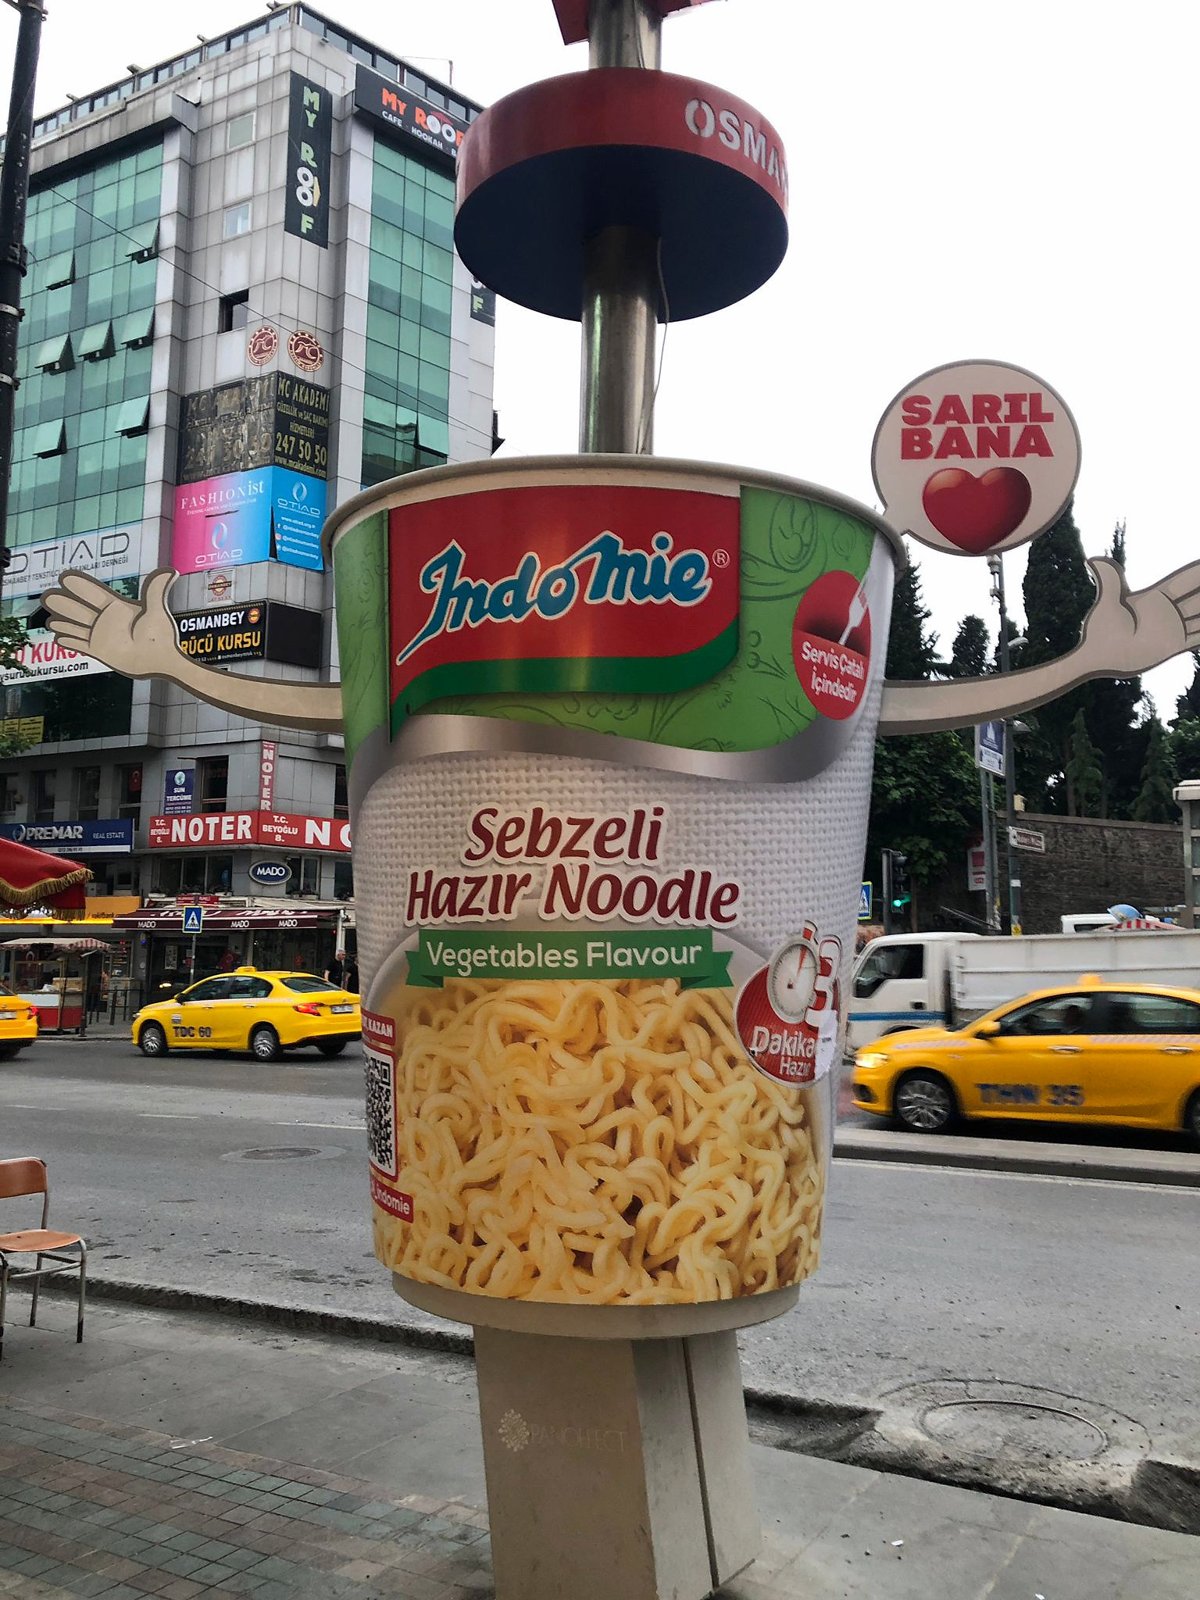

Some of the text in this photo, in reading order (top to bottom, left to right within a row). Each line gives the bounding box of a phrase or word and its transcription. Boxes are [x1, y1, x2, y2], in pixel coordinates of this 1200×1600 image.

[303, 86, 320, 128] MY
[382, 87, 407, 115] MY
[382, 110, 443, 150] CAFE HOOKAH
[901, 393, 1054, 426] SARIL
[275, 432, 327, 466] 247 50 50
[901, 425, 1054, 460] BANA
[396, 530, 712, 665] Indomie
[180, 611, 245, 633] OSMANBEY
[181, 633, 213, 656] RÜCÜ
[217, 631, 261, 652] KURSU
[801, 641, 840, 670] Servis
[260, 749, 275, 811] NOTER
[26, 825, 83, 840] PREMAR
[106, 831, 125, 839] ESTATE
[171, 815, 252, 843] NOTER
[262, 824, 299, 835] BEYOĞLU
[464, 806, 665, 861] Sebzeli
[256, 866, 286, 877] MADO
[407, 862, 740, 923] Hazır Noodle
[138, 920, 156, 928] MADO
[231, 919, 250, 928] MADO
[278, 918, 297, 927] MADO
[426, 941, 703, 977] Vegetables Flavour
[173, 1026, 195, 1038] TDC
[750, 1026, 816, 1060] Dakika
